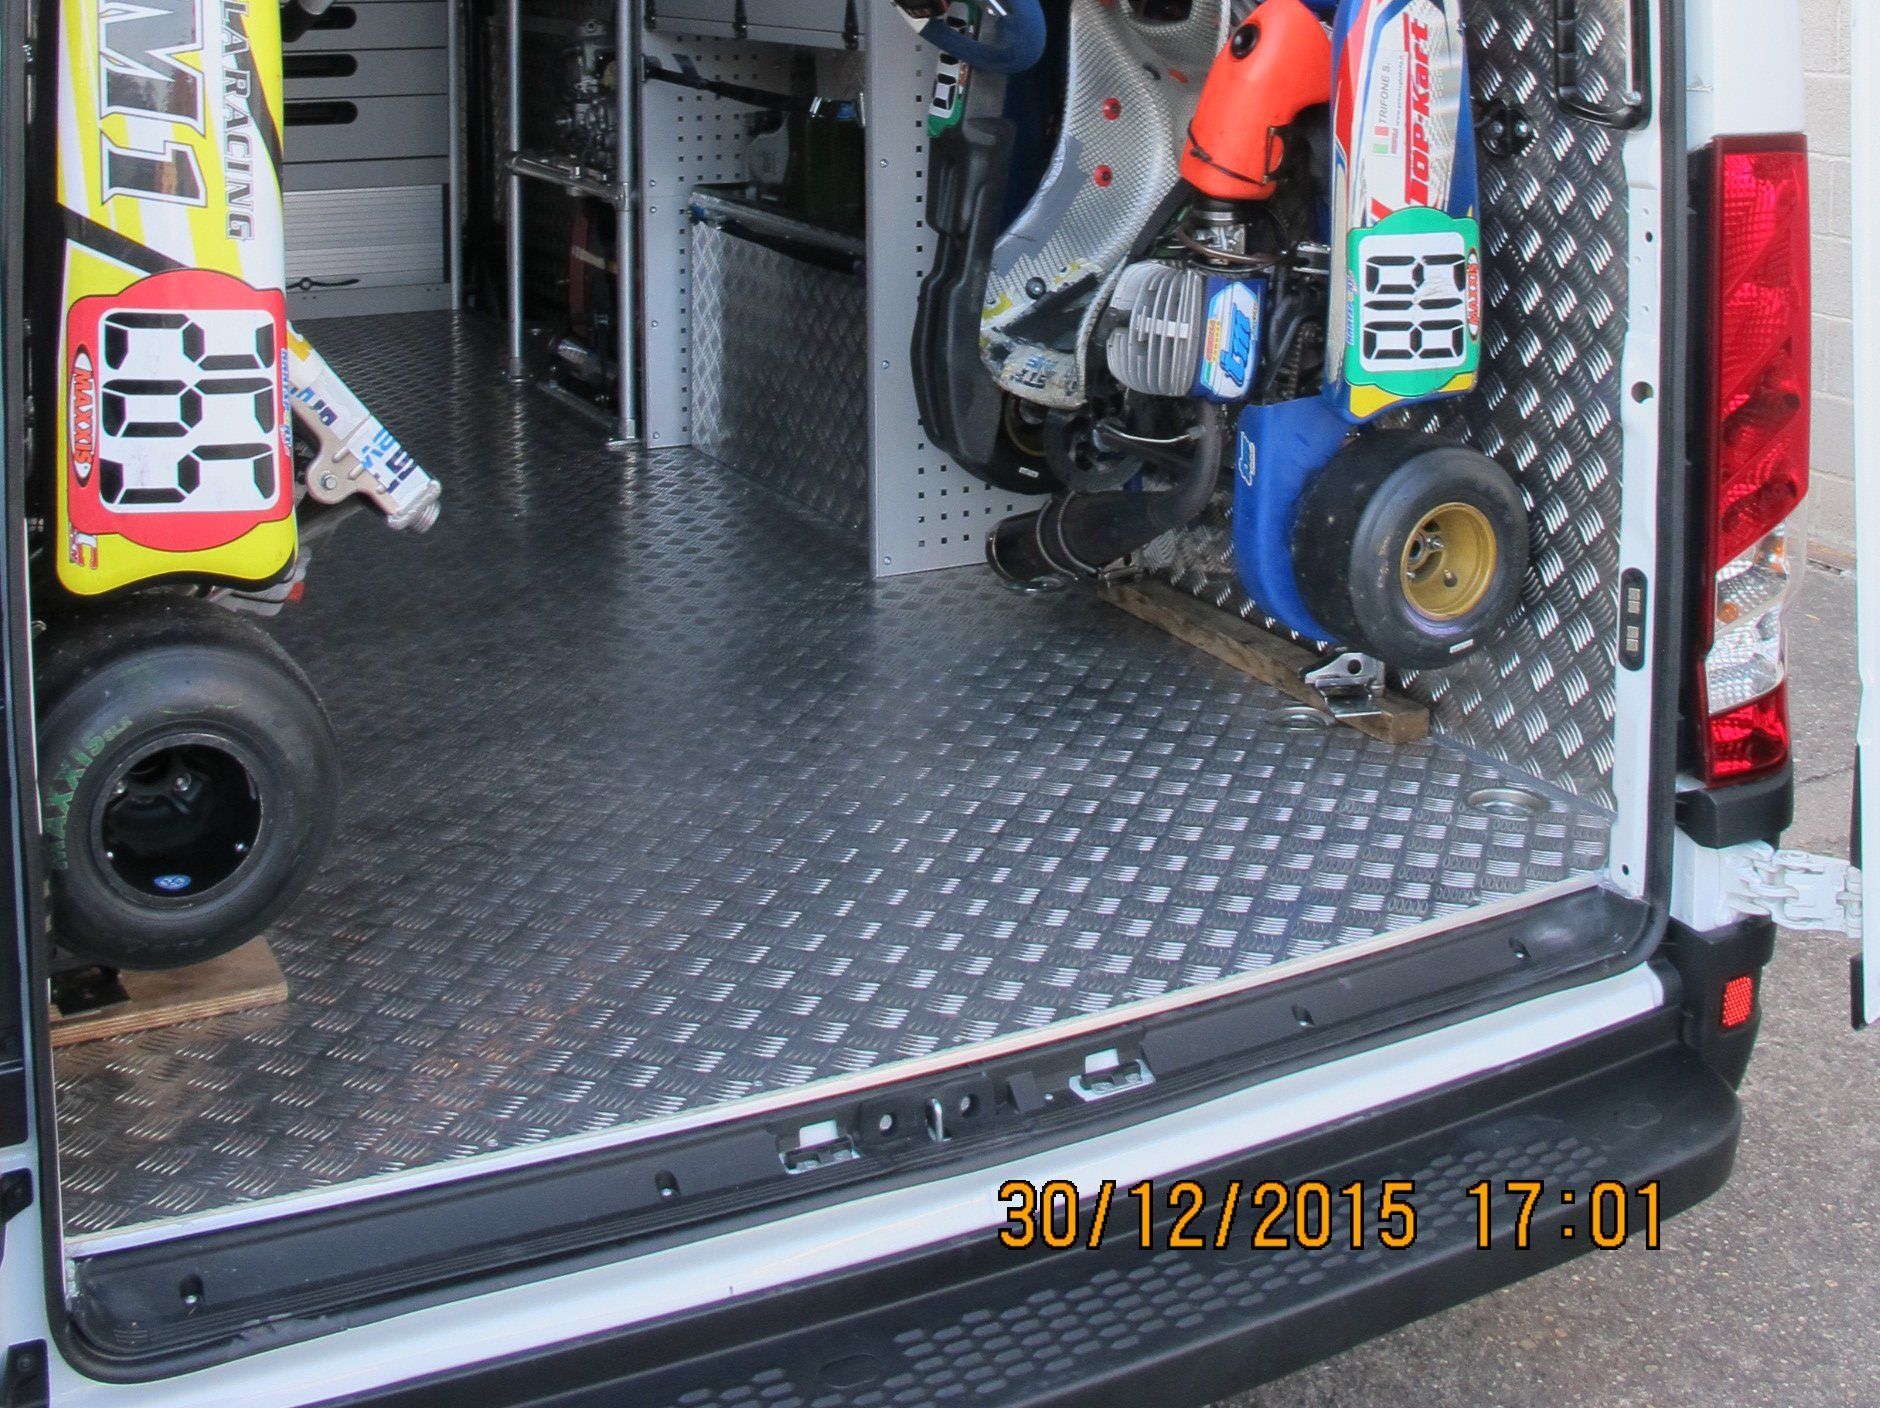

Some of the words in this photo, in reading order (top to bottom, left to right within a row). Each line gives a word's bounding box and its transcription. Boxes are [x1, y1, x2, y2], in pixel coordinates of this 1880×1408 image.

[1377, 75, 1390, 125] TRIFONE
[222, 67, 256, 242] RACING
[1362, 253, 1467, 361] 819
[1467, 262, 1480, 328] MAXXIS
[72, 367, 94, 468] MAXXIS
[100, 311, 276, 506] 265
